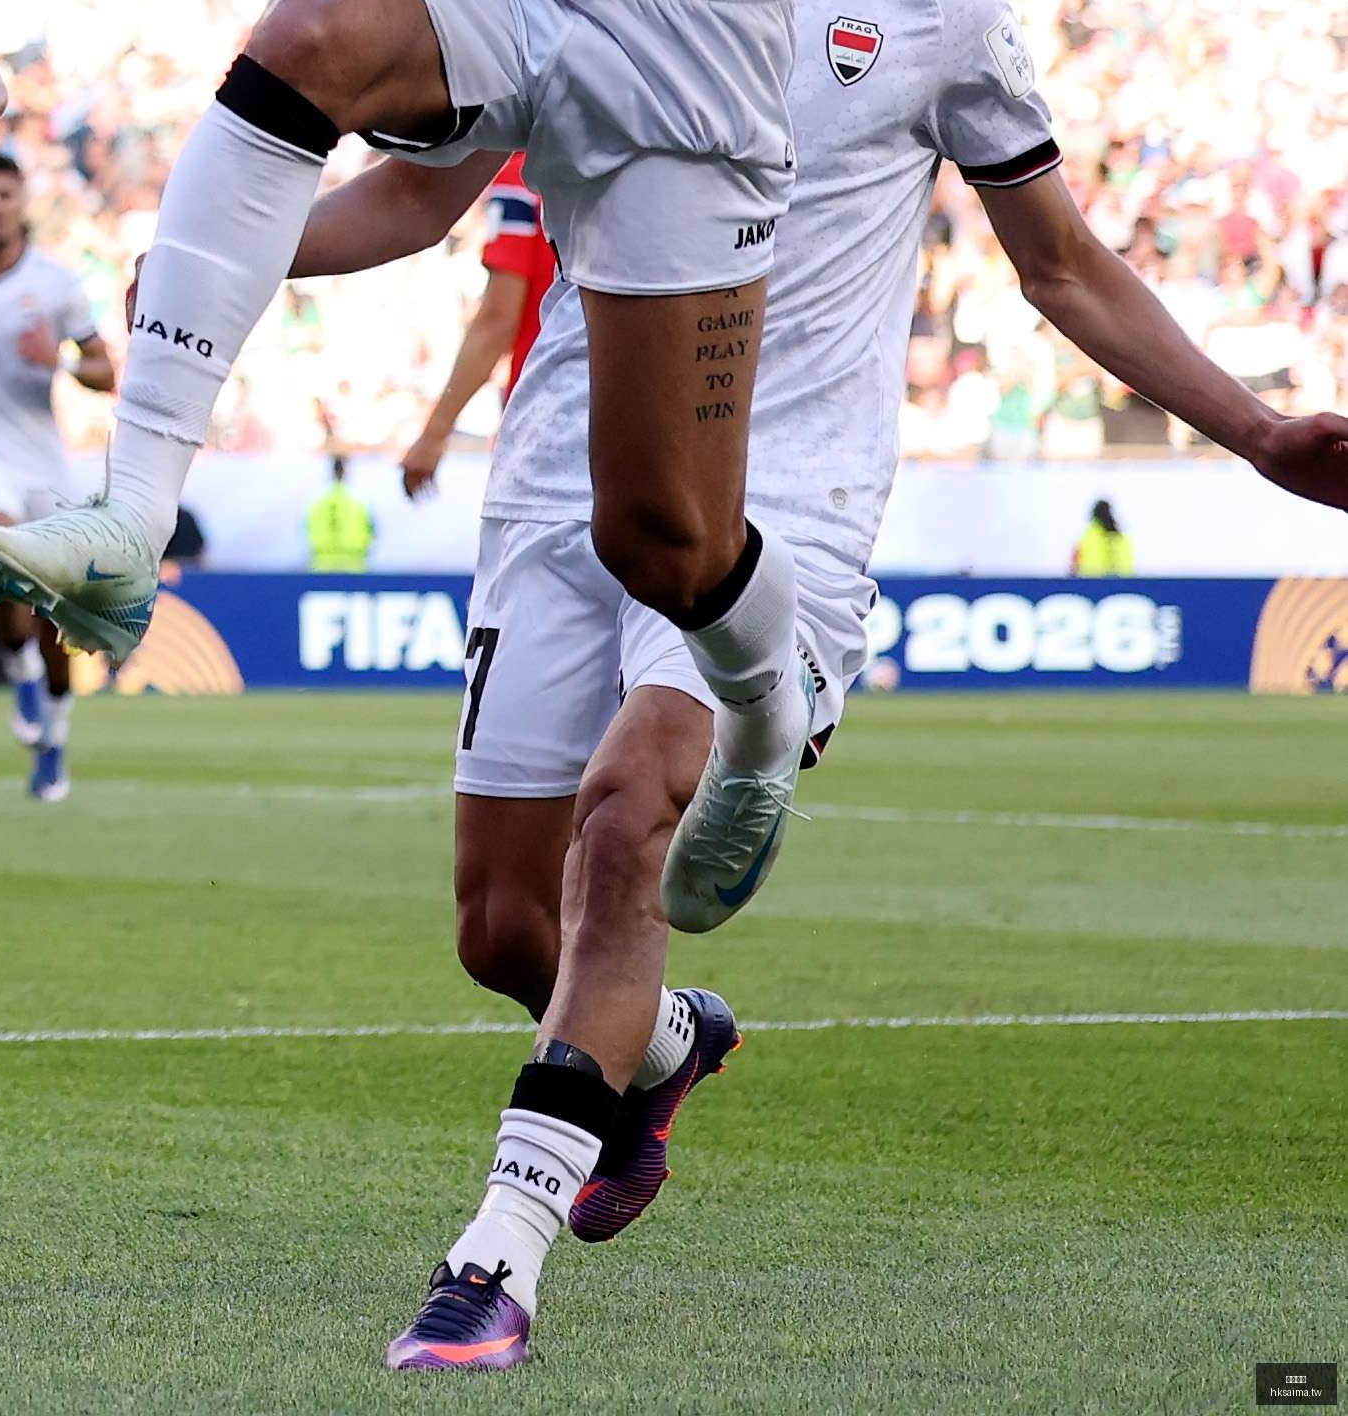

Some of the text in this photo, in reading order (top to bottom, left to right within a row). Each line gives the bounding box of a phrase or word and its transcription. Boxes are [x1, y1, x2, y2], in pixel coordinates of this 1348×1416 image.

[841, 22, 872, 34] IRAQ
[734, 219, 776, 250] JAKO
[697, 309, 754, 332] GAME
[135, 313, 213, 358] JAKO
[696, 339, 749, 362] PLAY
[706, 372, 734, 390] TO
[695, 401, 736, 422] WIN
[298, 591, 465, 671] FIFA
[905, 592, 1160, 673] 2026
[491, 1158, 561, 1195] JAKO
